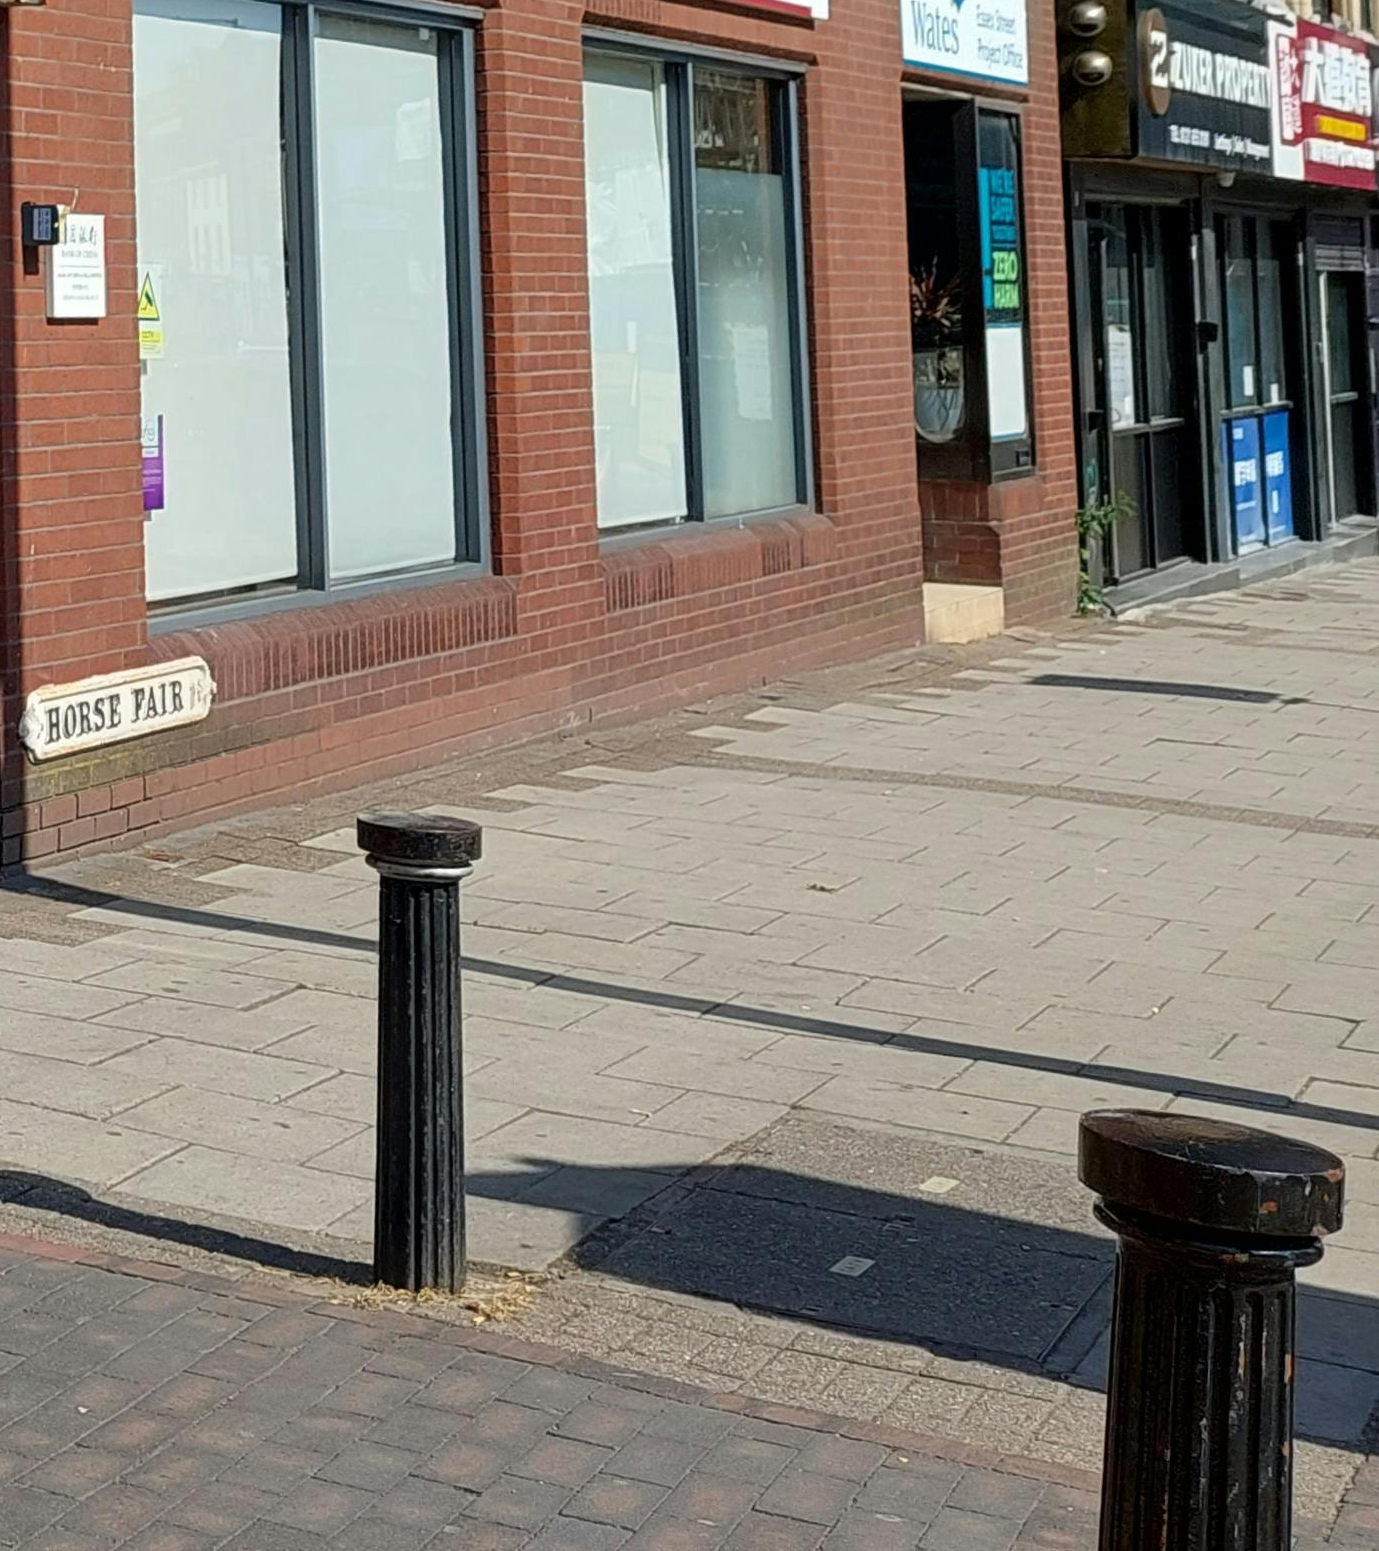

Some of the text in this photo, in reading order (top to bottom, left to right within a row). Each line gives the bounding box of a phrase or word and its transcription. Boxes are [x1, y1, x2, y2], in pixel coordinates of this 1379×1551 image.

[911, 0, 960, 55] Wates
[977, 37, 1024, 69] Project Office
[992, 251, 1018, 281] ZERO
[44, 693, 121, 745] HORSE
[131, 680, 184, 723] FAIR
